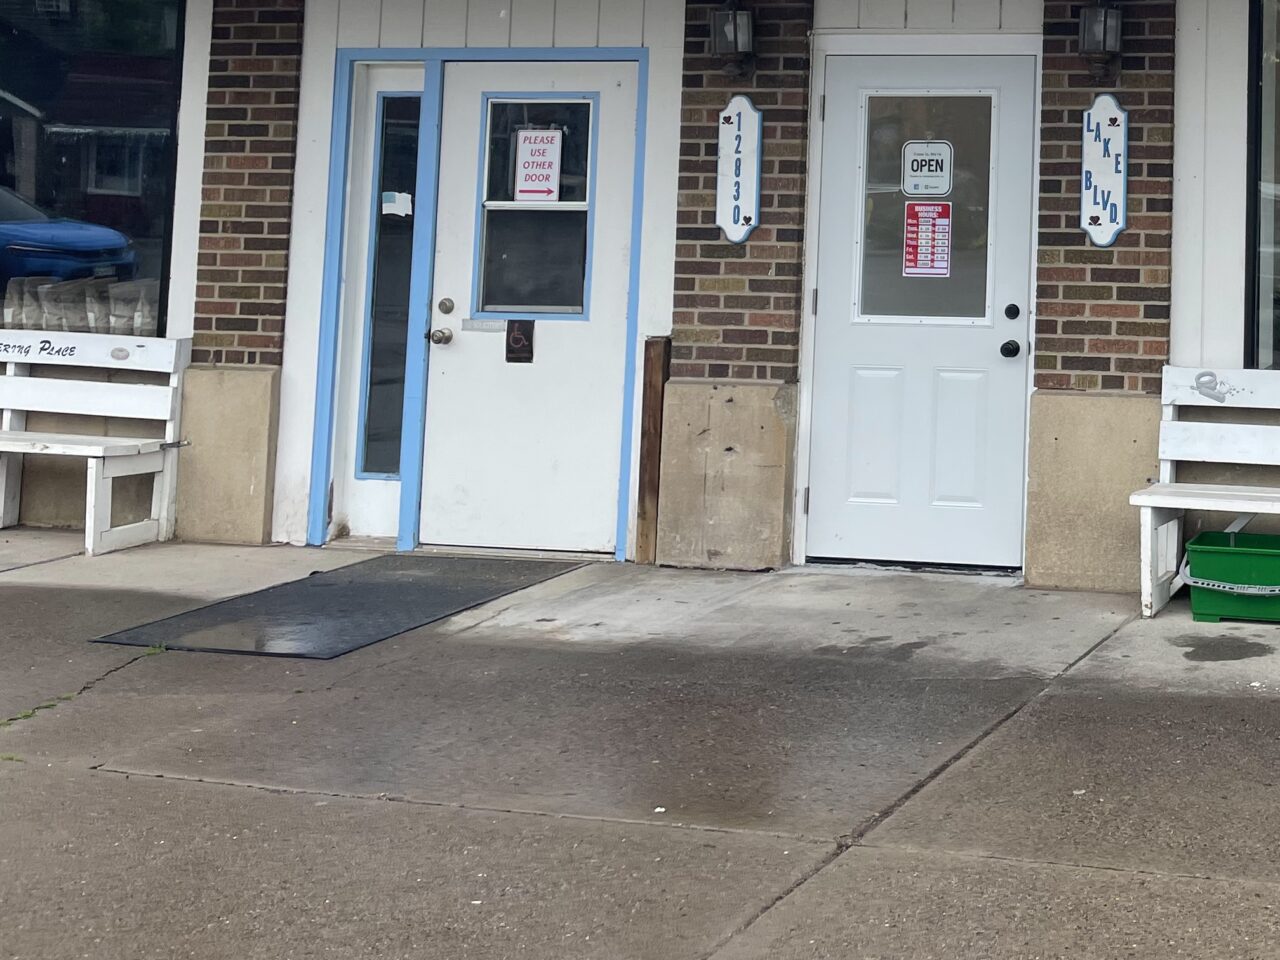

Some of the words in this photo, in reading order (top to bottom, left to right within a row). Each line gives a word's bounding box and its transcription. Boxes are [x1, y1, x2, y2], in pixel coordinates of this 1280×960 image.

[522, 135, 556, 144] PLEASE
[1086, 112, 1122, 174] LAKE
[530, 148, 547, 157] USE
[522, 161, 553, 169] OTHER
[732, 111, 742, 225] 12830
[911, 158, 944, 173] OPEN
[524, 173, 551, 182] DOOR
[39, 340, 76, 356] PLACE
